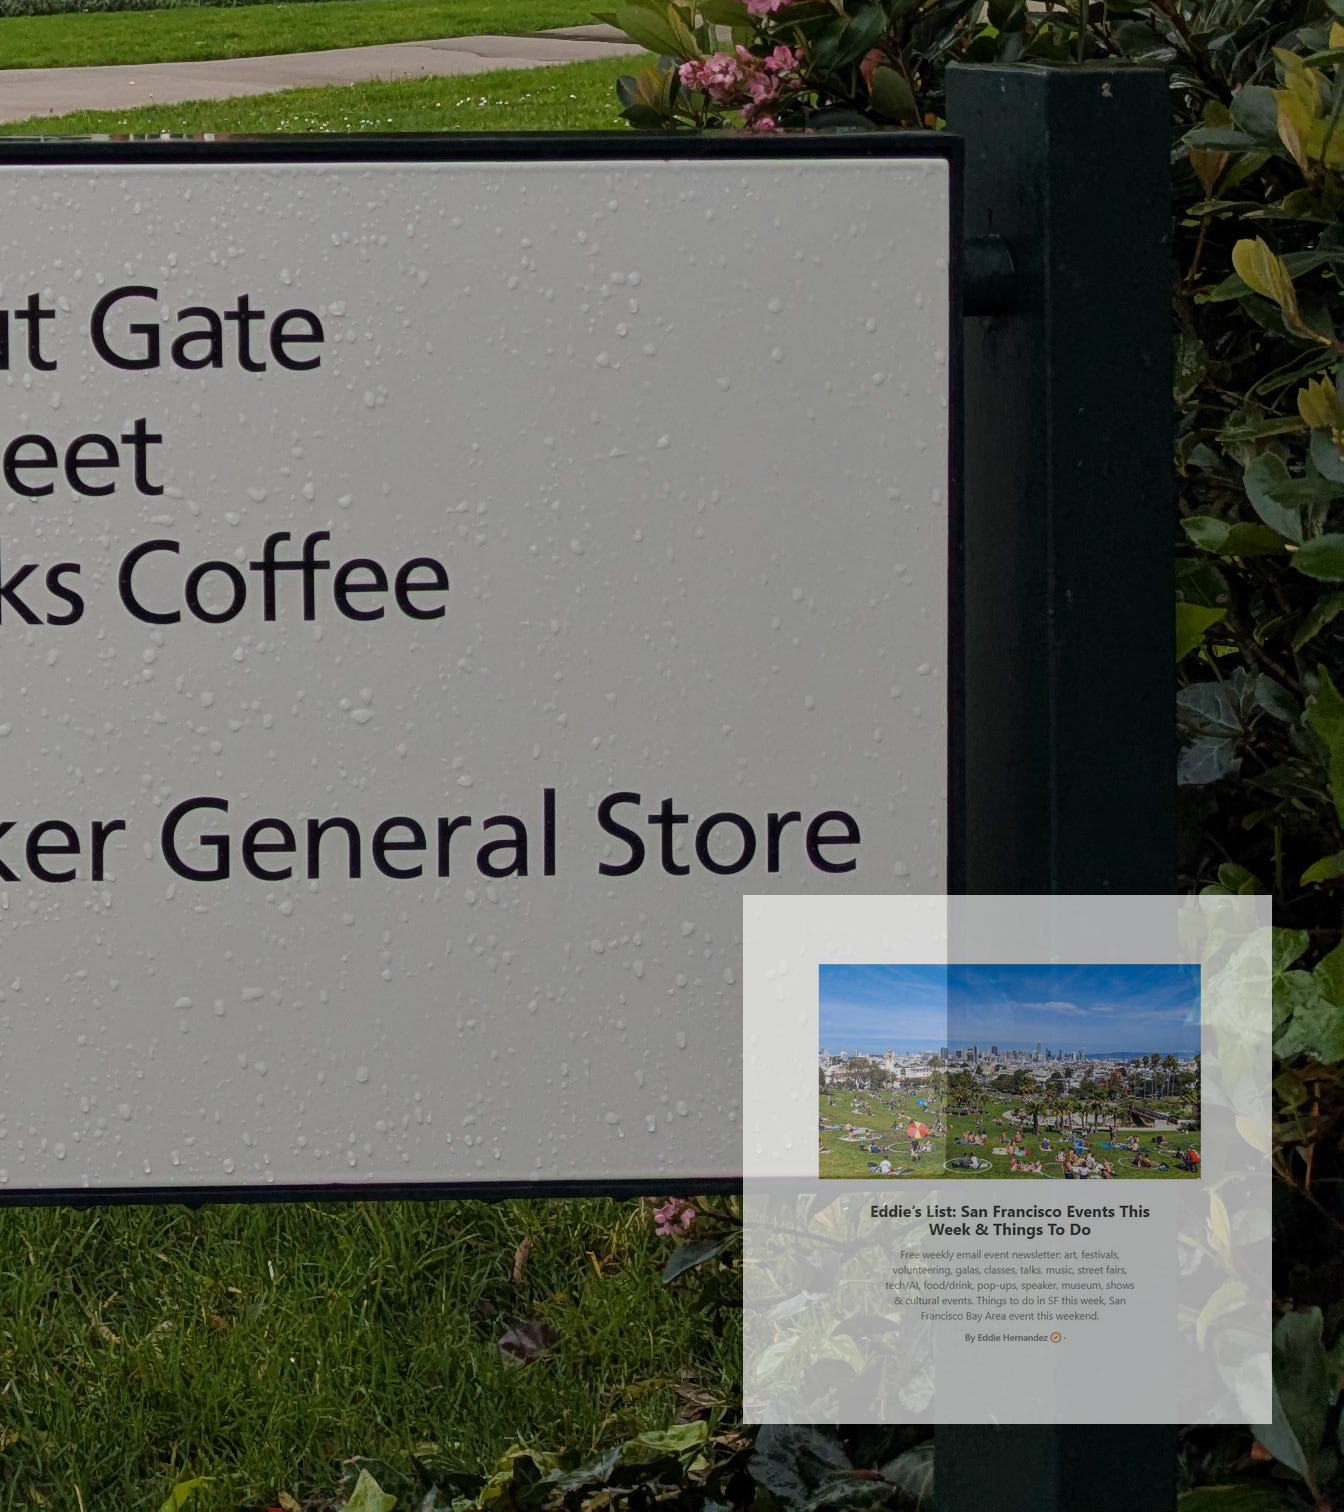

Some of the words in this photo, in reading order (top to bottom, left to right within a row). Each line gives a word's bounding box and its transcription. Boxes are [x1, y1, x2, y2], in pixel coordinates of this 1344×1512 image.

[90, 285, 325, 373] Gate
[118, 530, 450, 625] Coffee
[161, 787, 556, 883] General
[597, 791, 861, 877] Store
